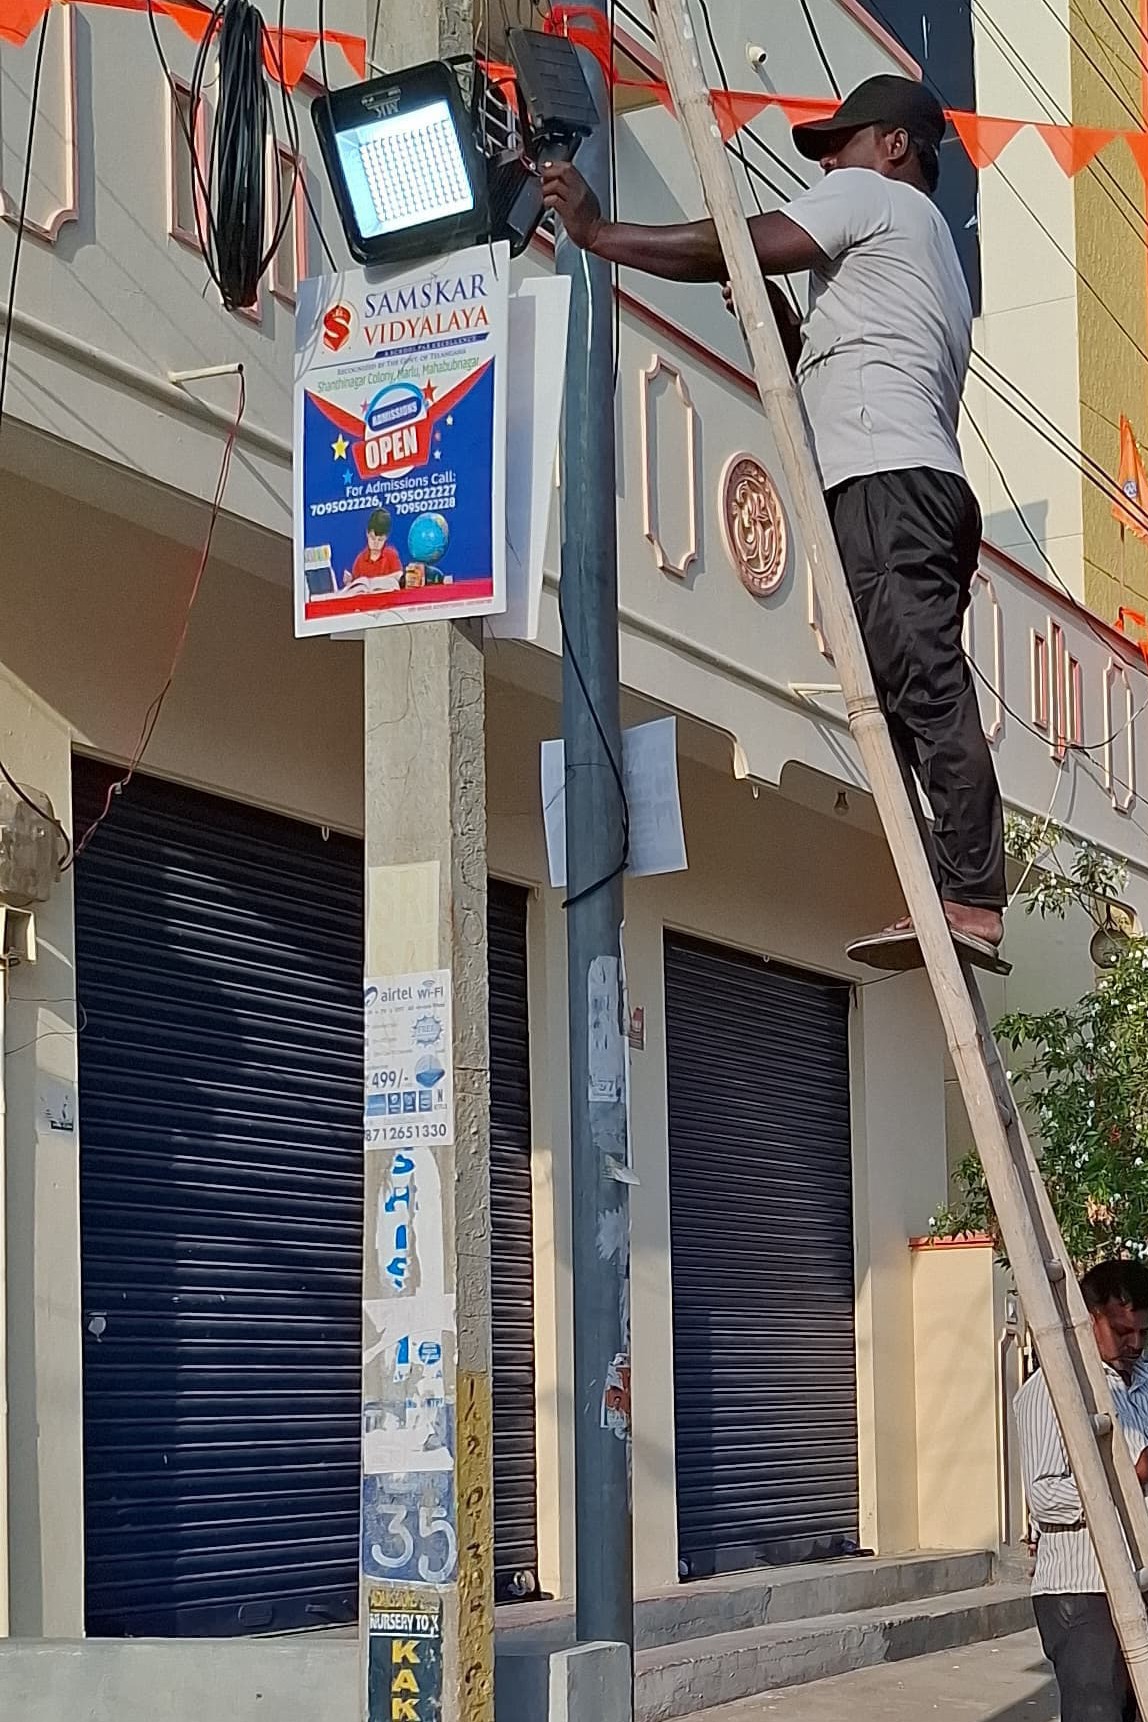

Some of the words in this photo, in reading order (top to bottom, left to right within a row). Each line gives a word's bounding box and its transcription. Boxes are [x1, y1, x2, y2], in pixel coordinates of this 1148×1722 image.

[365, 274, 488, 318] SAMSKAR
[364, 305, 490, 346] VIDYALAYA
[318, 375, 366, 393] Shanthinagar
[368, 370, 397, 386] Colony,
[423, 356, 480, 376] Mahabubnagar
[366, 425, 418, 469] OPEN
[310, 496, 382, 516] 7095022226,
[384, 484, 457, 505] 7095022227
[346, 485, 363, 498] For
[365, 477, 429, 494] Admissions
[431, 470, 456, 485] Call:
[381, 986, 412, 1002] airtel
[372, 1504, 457, 1584] 35
[369, 1613, 415, 1632] NURSERY
[415, 1614, 429, 1631] TO
